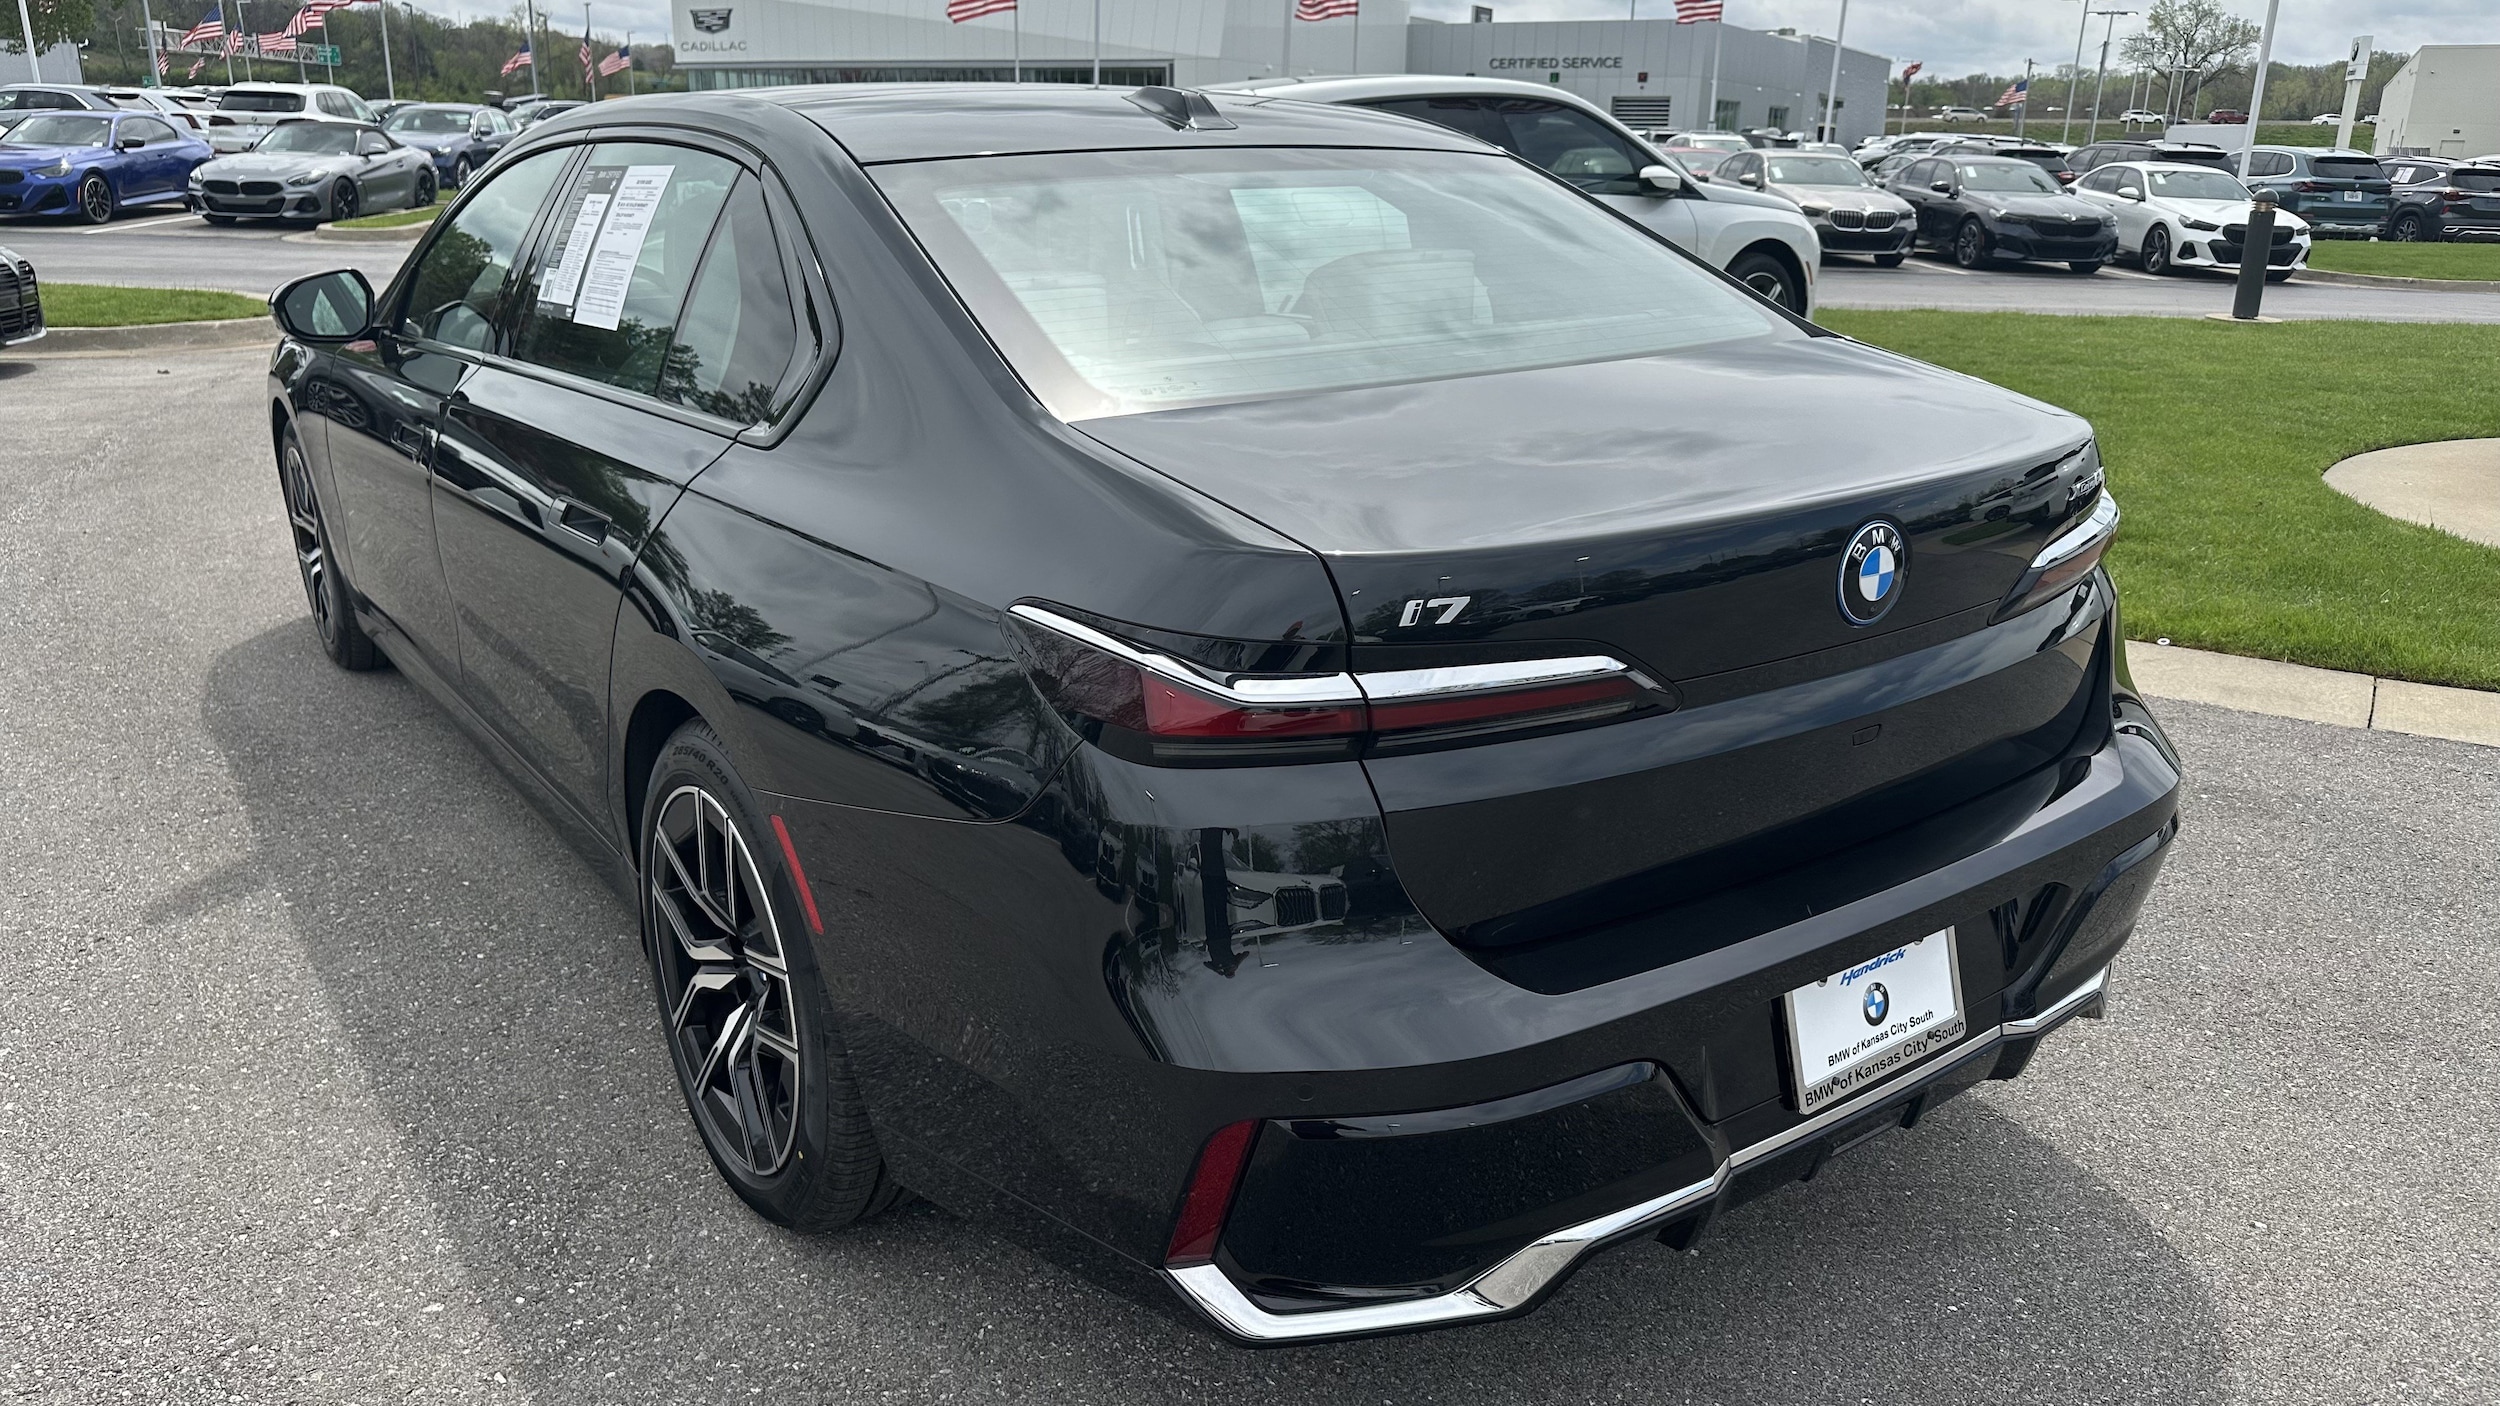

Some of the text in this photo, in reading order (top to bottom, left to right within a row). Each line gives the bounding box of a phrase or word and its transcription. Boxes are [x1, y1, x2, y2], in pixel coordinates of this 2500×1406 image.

[681, 41, 747, 52] CADILLAC
[1489, 57, 1622, 69] CERTIFIED SERVICE
[1851, 528, 1901, 562] BMW
[1398, 596, 1471, 627] i7
[672, 745, 706, 762] 285/40
[706, 759, 729, 785] R20
[1840, 948, 1906, 986] Hendrick
[1828, 1009, 1934, 1067] BMW of Kansas City South
[1805, 1020, 1965, 1107] BMW of Kansas City South
